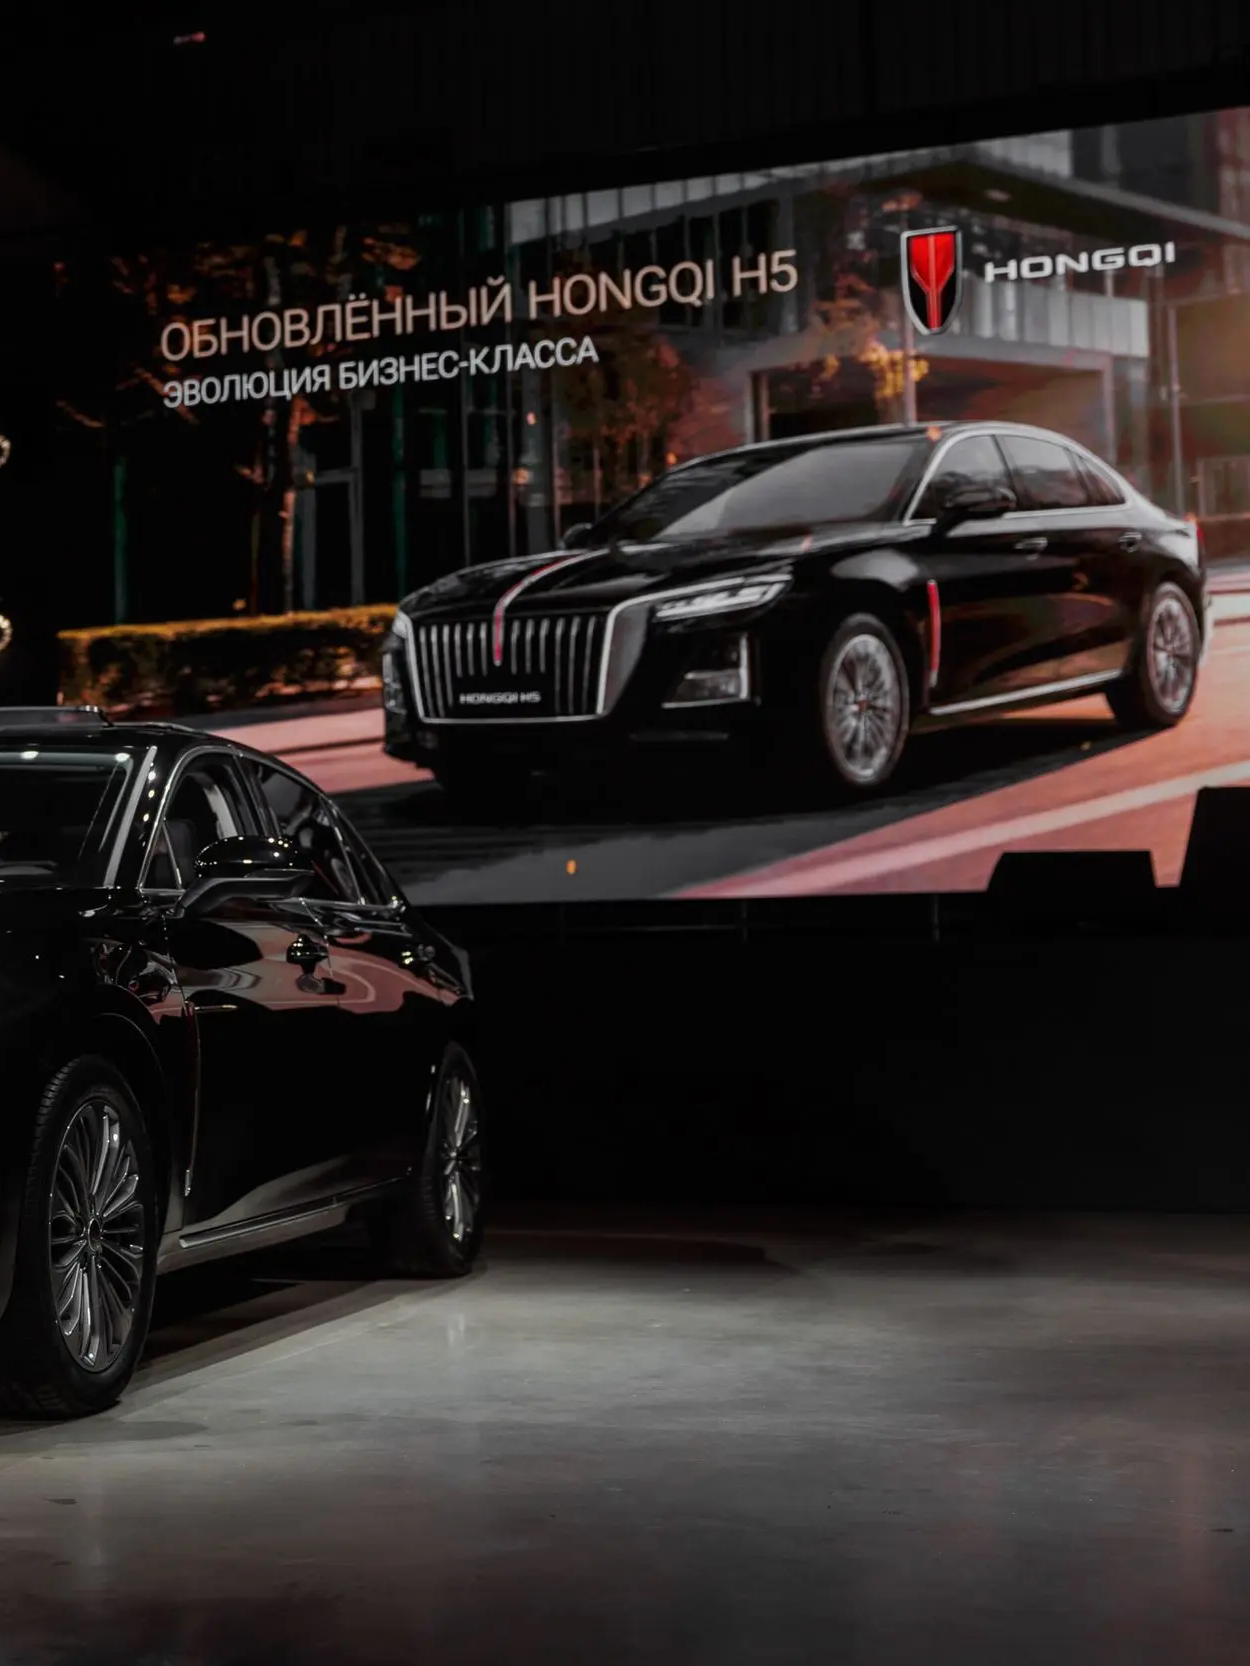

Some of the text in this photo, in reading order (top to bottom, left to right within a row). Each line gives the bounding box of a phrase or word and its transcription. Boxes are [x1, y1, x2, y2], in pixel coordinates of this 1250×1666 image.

[984, 241, 1175, 283] HONGQI
[160, 249, 798, 362] ОБНОВЛЁННЫЙ HONGQI H5
[162, 334, 600, 409] ЭВОЛЮЦИЯ БИЗНЕС-КЛАССА
